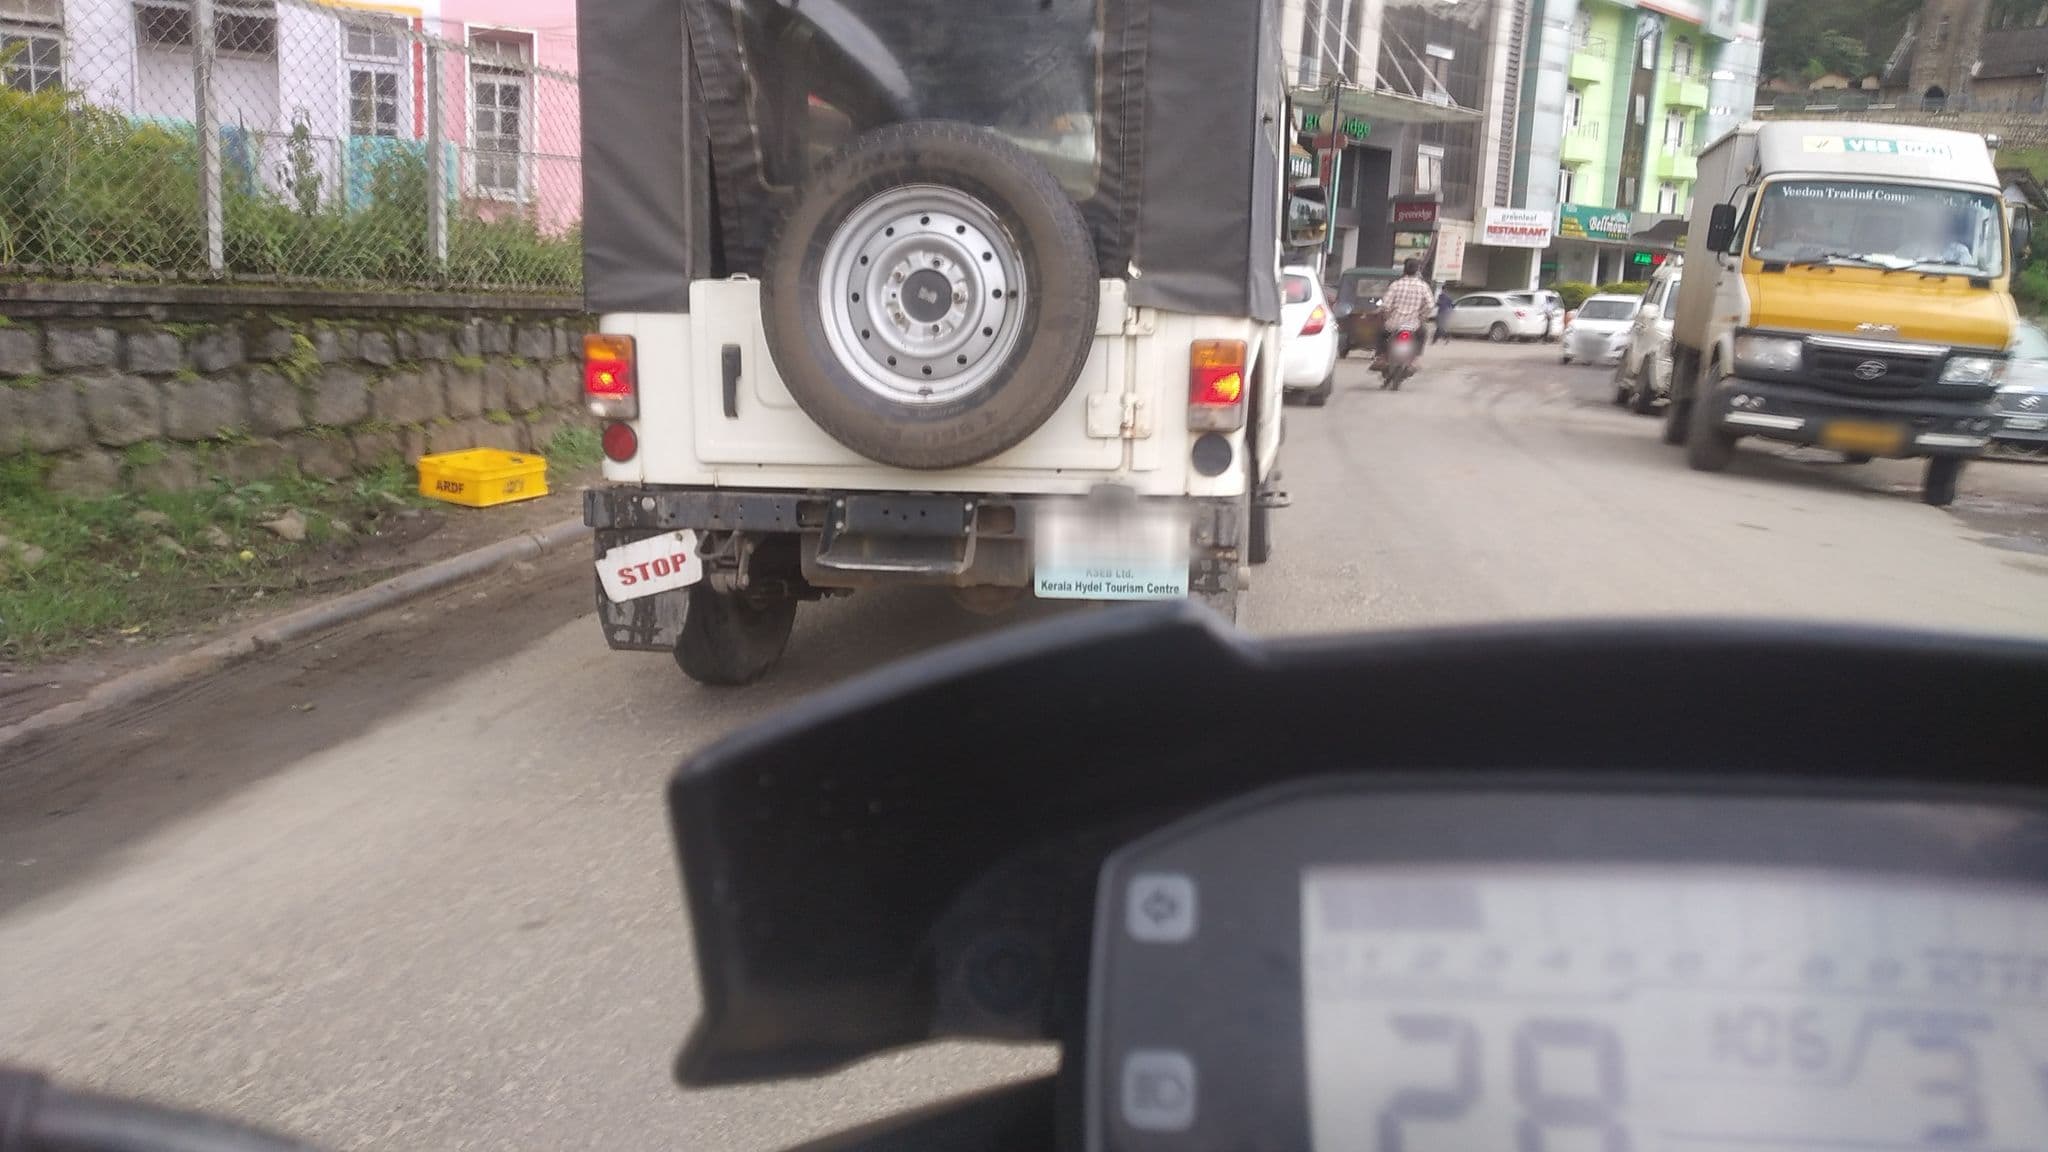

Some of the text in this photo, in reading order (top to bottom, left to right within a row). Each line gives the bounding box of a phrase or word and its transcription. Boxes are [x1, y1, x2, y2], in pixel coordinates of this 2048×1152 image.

[1782, 185, 1824, 198] Veedon
[1825, 187, 1873, 200] Trading
[1487, 225, 1549, 237] RESTAURANT
[617, 552, 687, 586] STOP
[1115, 568, 1134, 579] Ltd.
[1041, 580, 1180, 594] Kerala Hydel Tourism Centre
